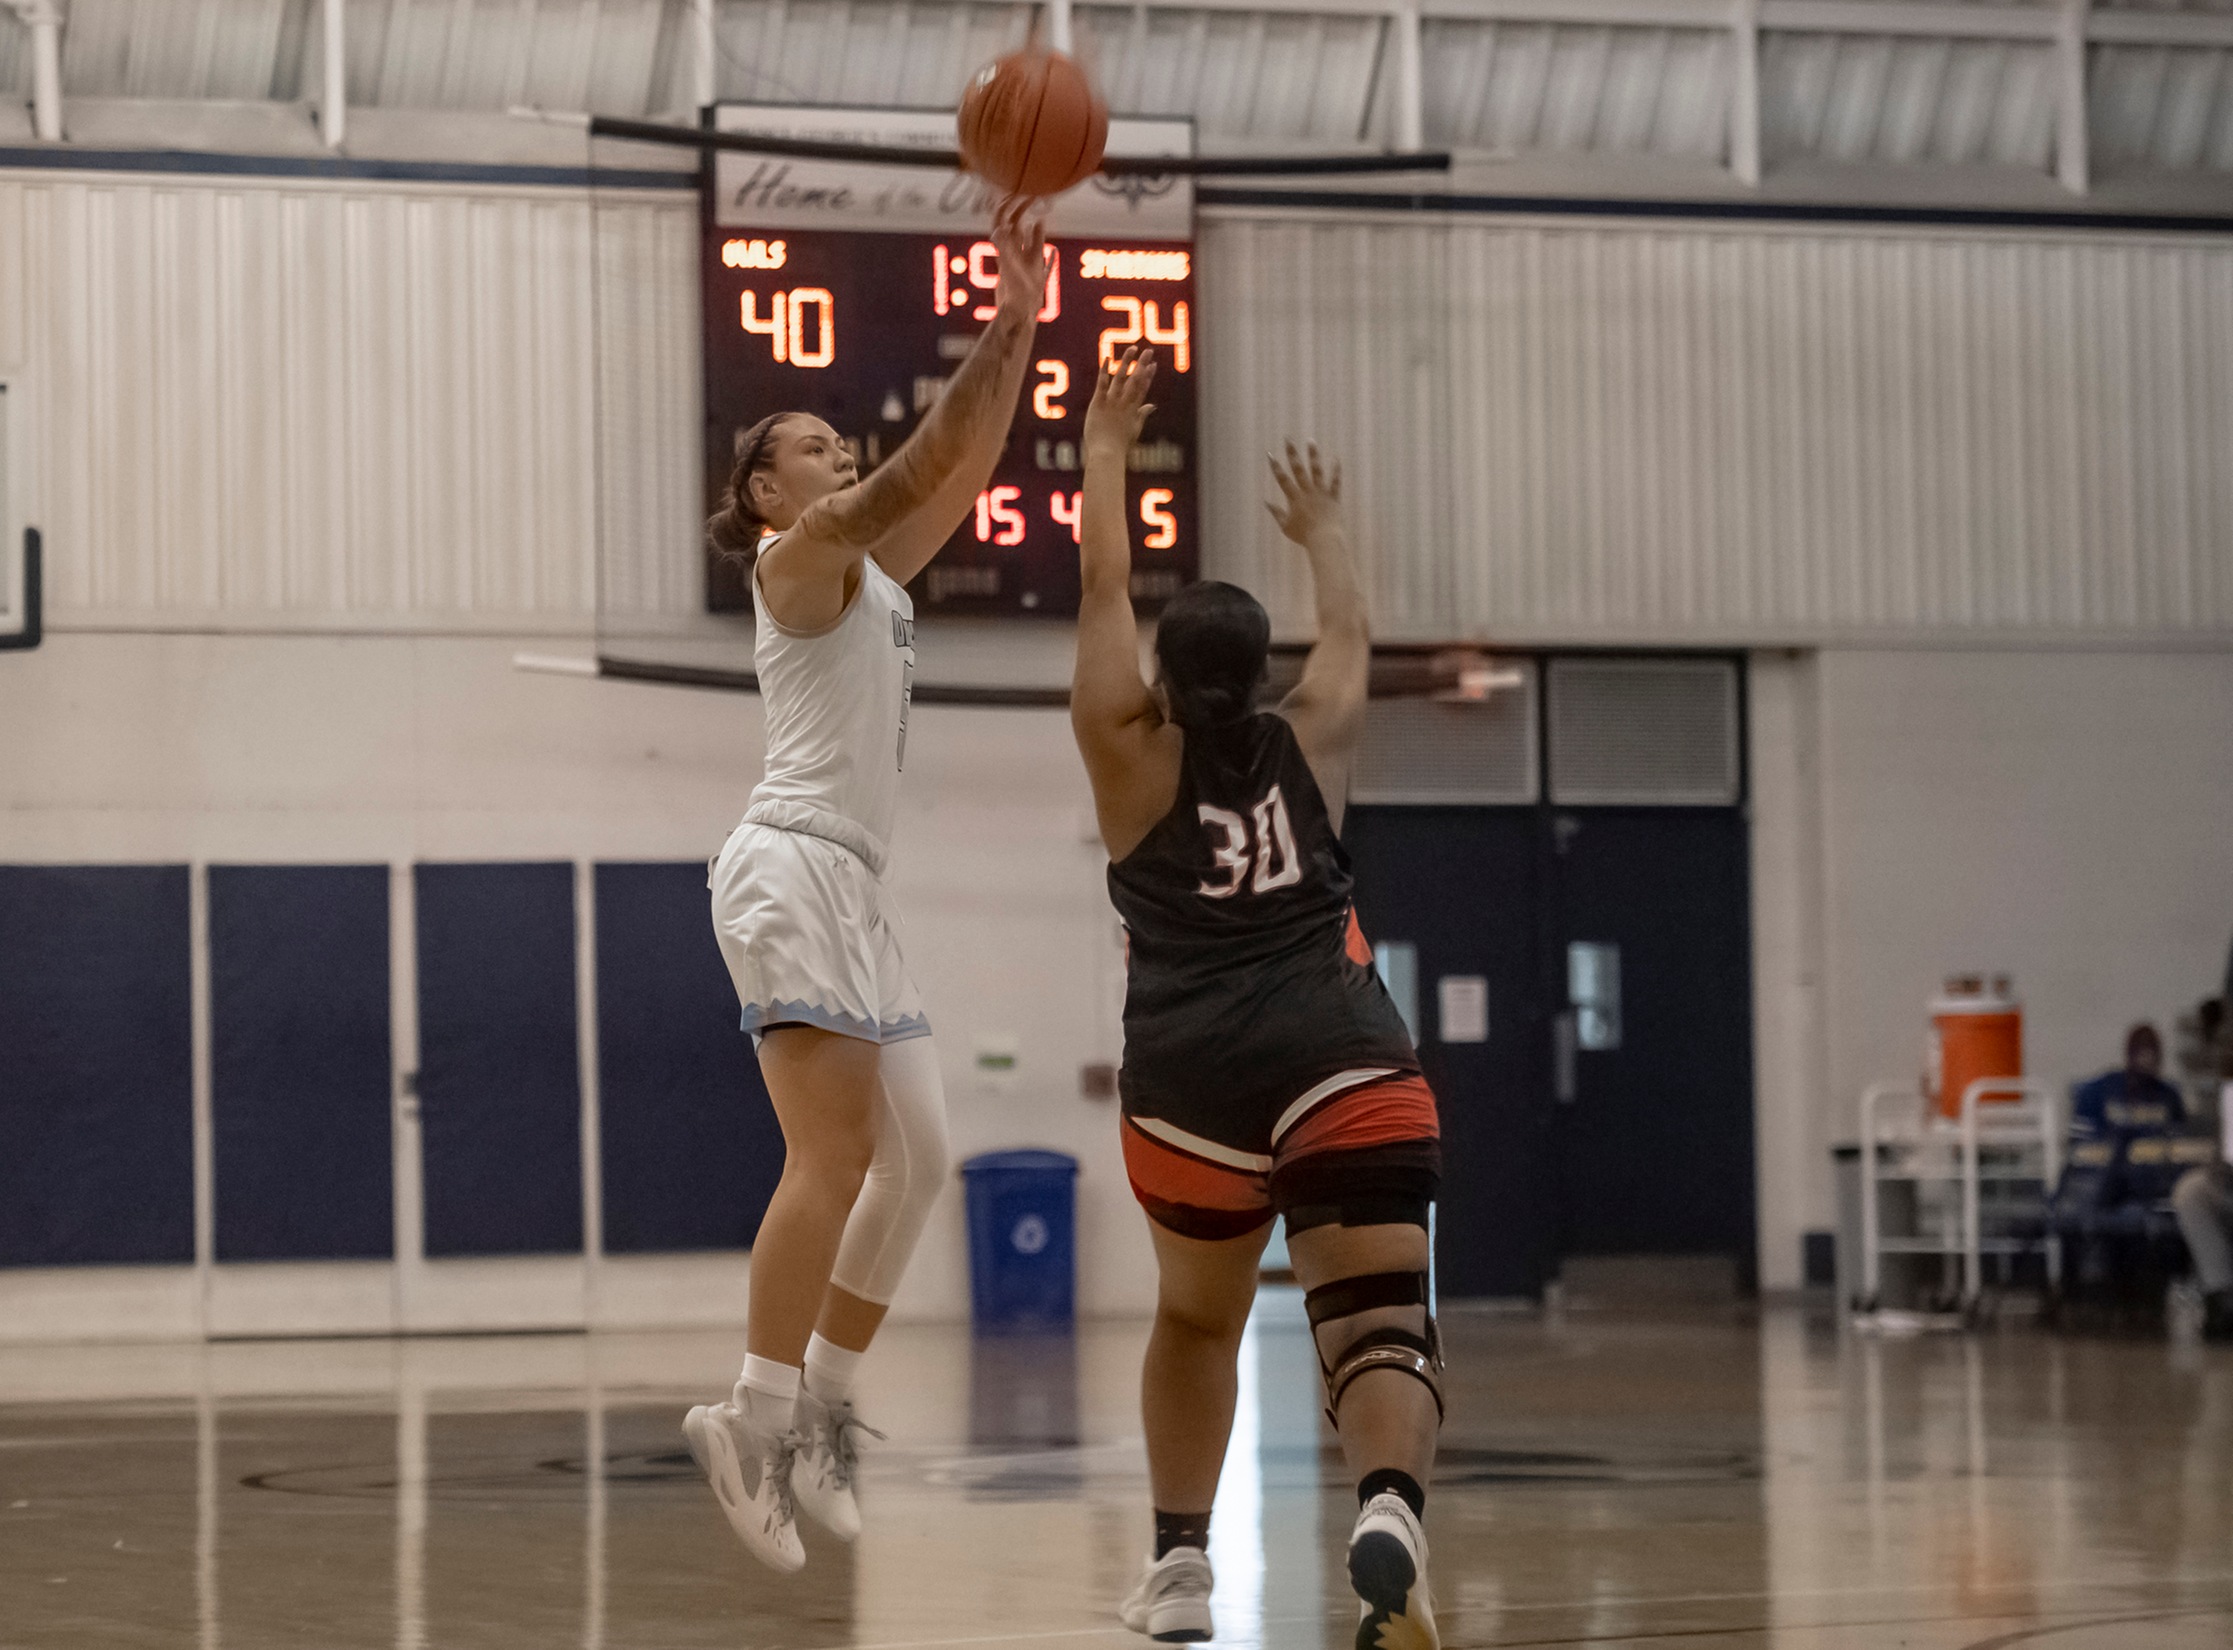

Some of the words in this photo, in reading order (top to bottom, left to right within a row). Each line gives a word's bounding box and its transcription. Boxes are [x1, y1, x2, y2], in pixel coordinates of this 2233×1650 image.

[740, 287, 835, 368] 40
[1098, 295, 1191, 374] 24
[1033, 359, 1070, 419] 2
[974, 485, 1026, 546] 15
[1050, 490, 1083, 544] 4
[1140, 487, 1177, 549] 5
[1197, 783, 1301, 899] 30
